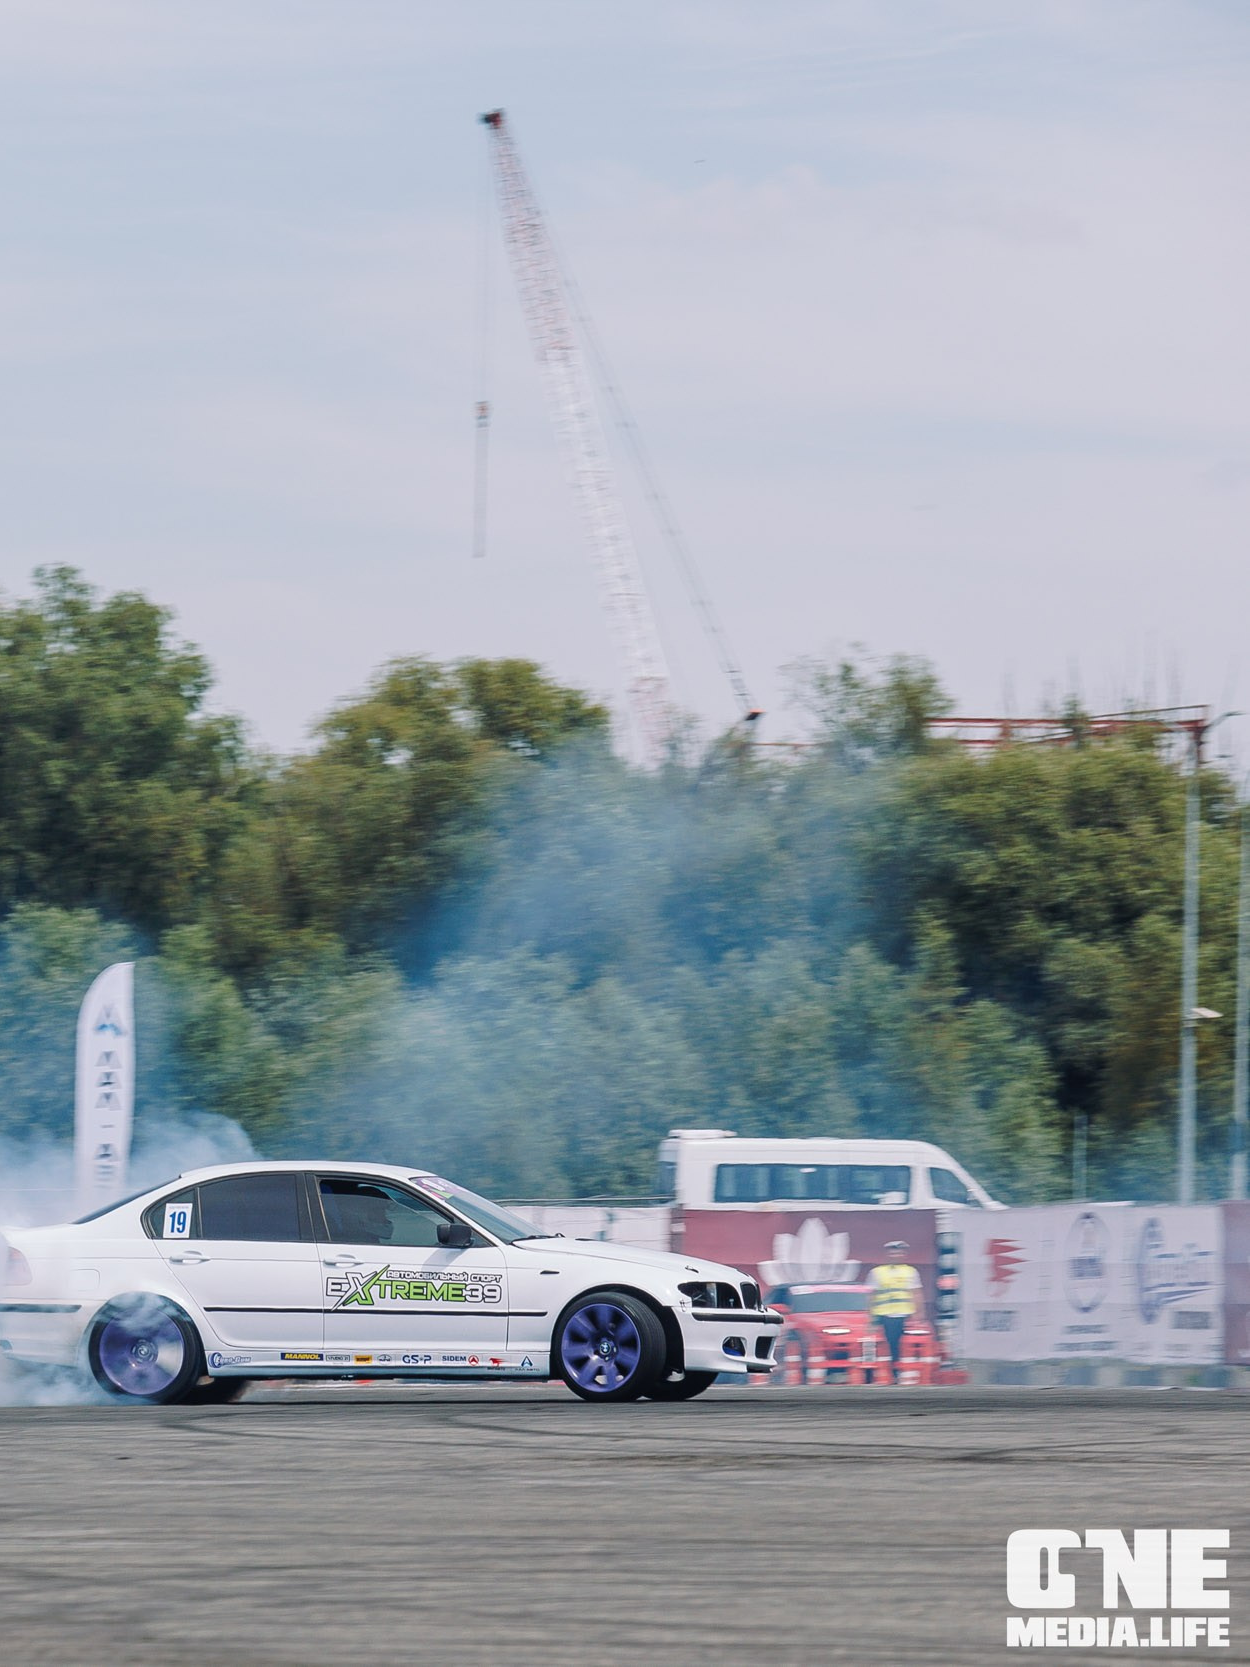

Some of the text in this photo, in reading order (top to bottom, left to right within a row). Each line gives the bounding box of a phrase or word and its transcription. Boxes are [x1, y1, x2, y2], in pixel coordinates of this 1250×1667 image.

[169, 1211, 187, 1233] 19
[386, 1270, 502, 1283] АВТОМОБИЛЬНЫЙ СПОРТ
[326, 1265, 502, 1311] EXTREME39
